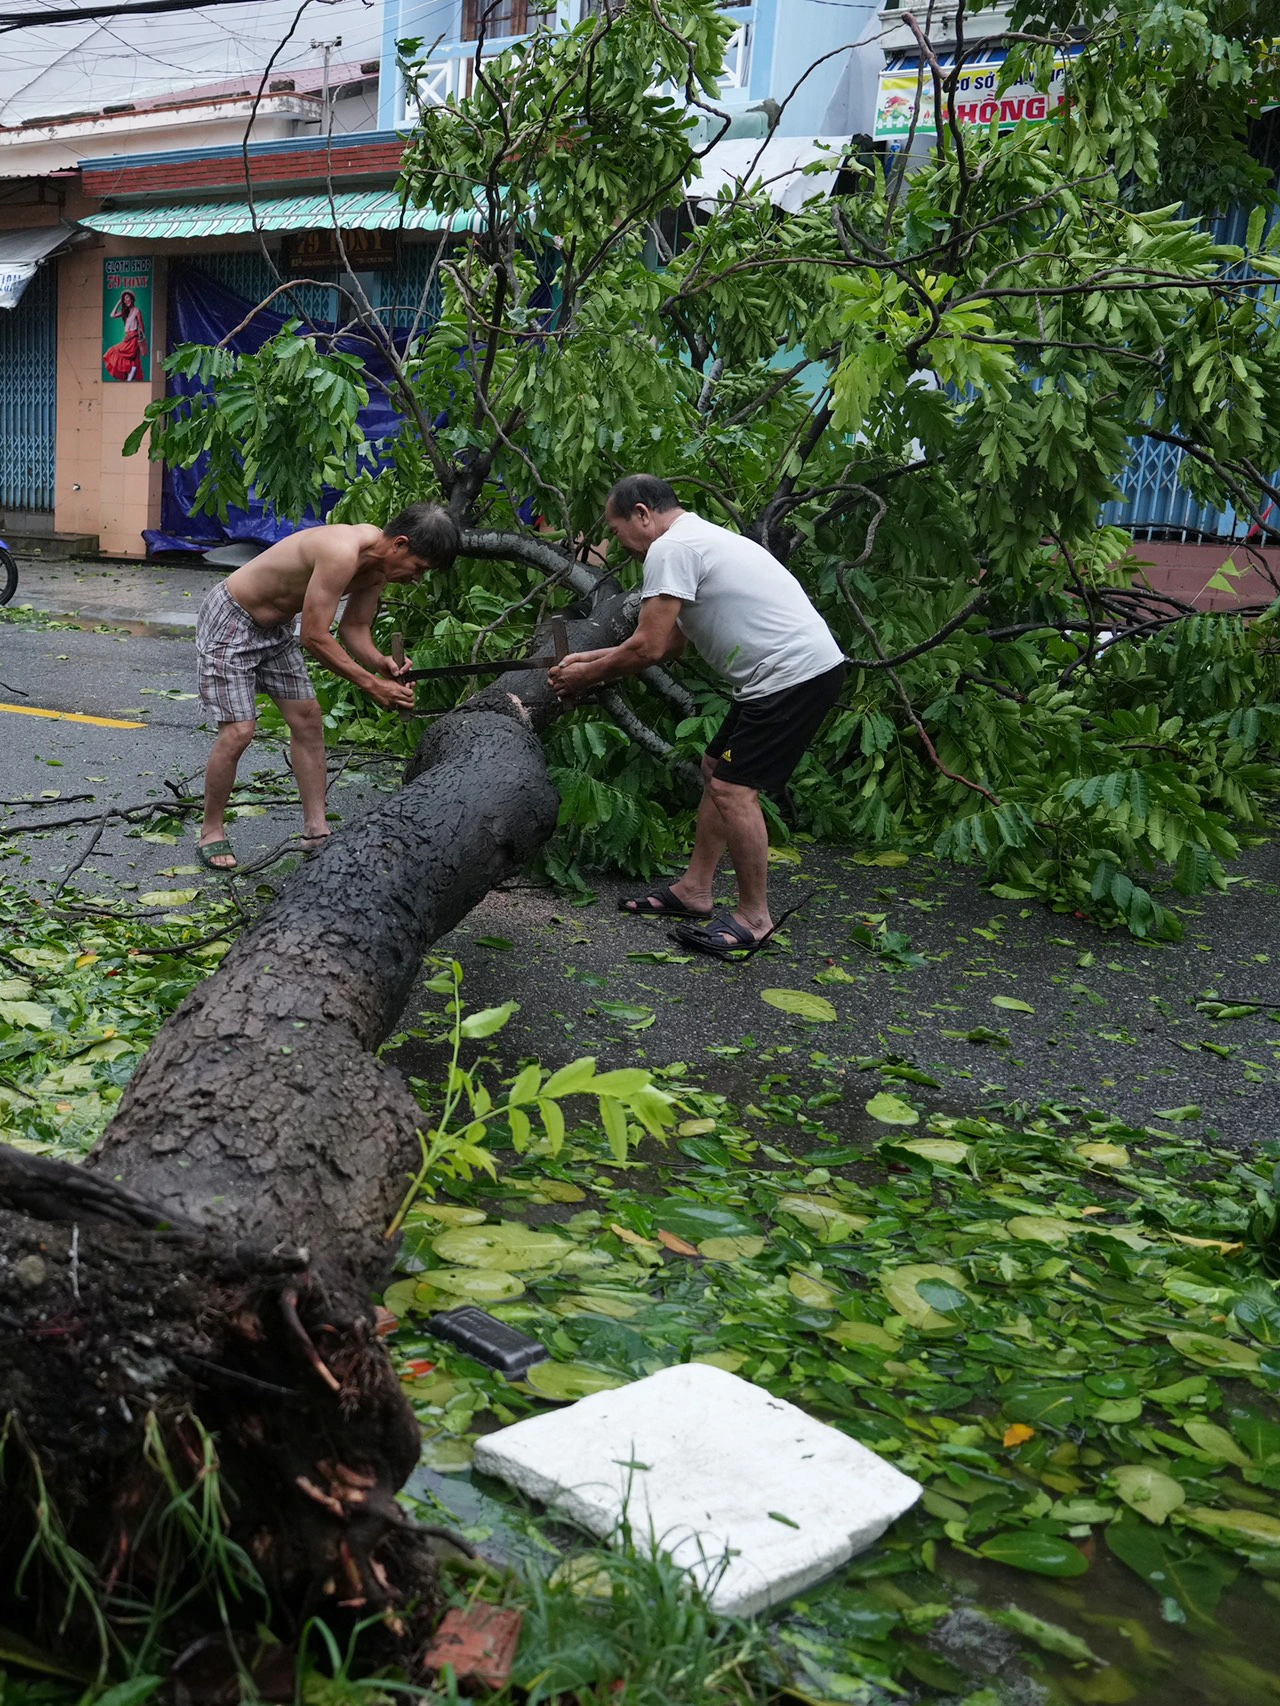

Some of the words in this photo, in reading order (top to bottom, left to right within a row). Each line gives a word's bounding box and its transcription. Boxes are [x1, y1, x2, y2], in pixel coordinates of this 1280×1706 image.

[974, 71, 995, 90] SỞ
[296, 231, 320, 253] 79
[328, 229, 383, 252] TONY
[106, 260, 130, 273] CLOTH
[131, 259, 151, 272] SHOP
[107, 274, 121, 289] 79
[122, 275, 149, 288] TONY
